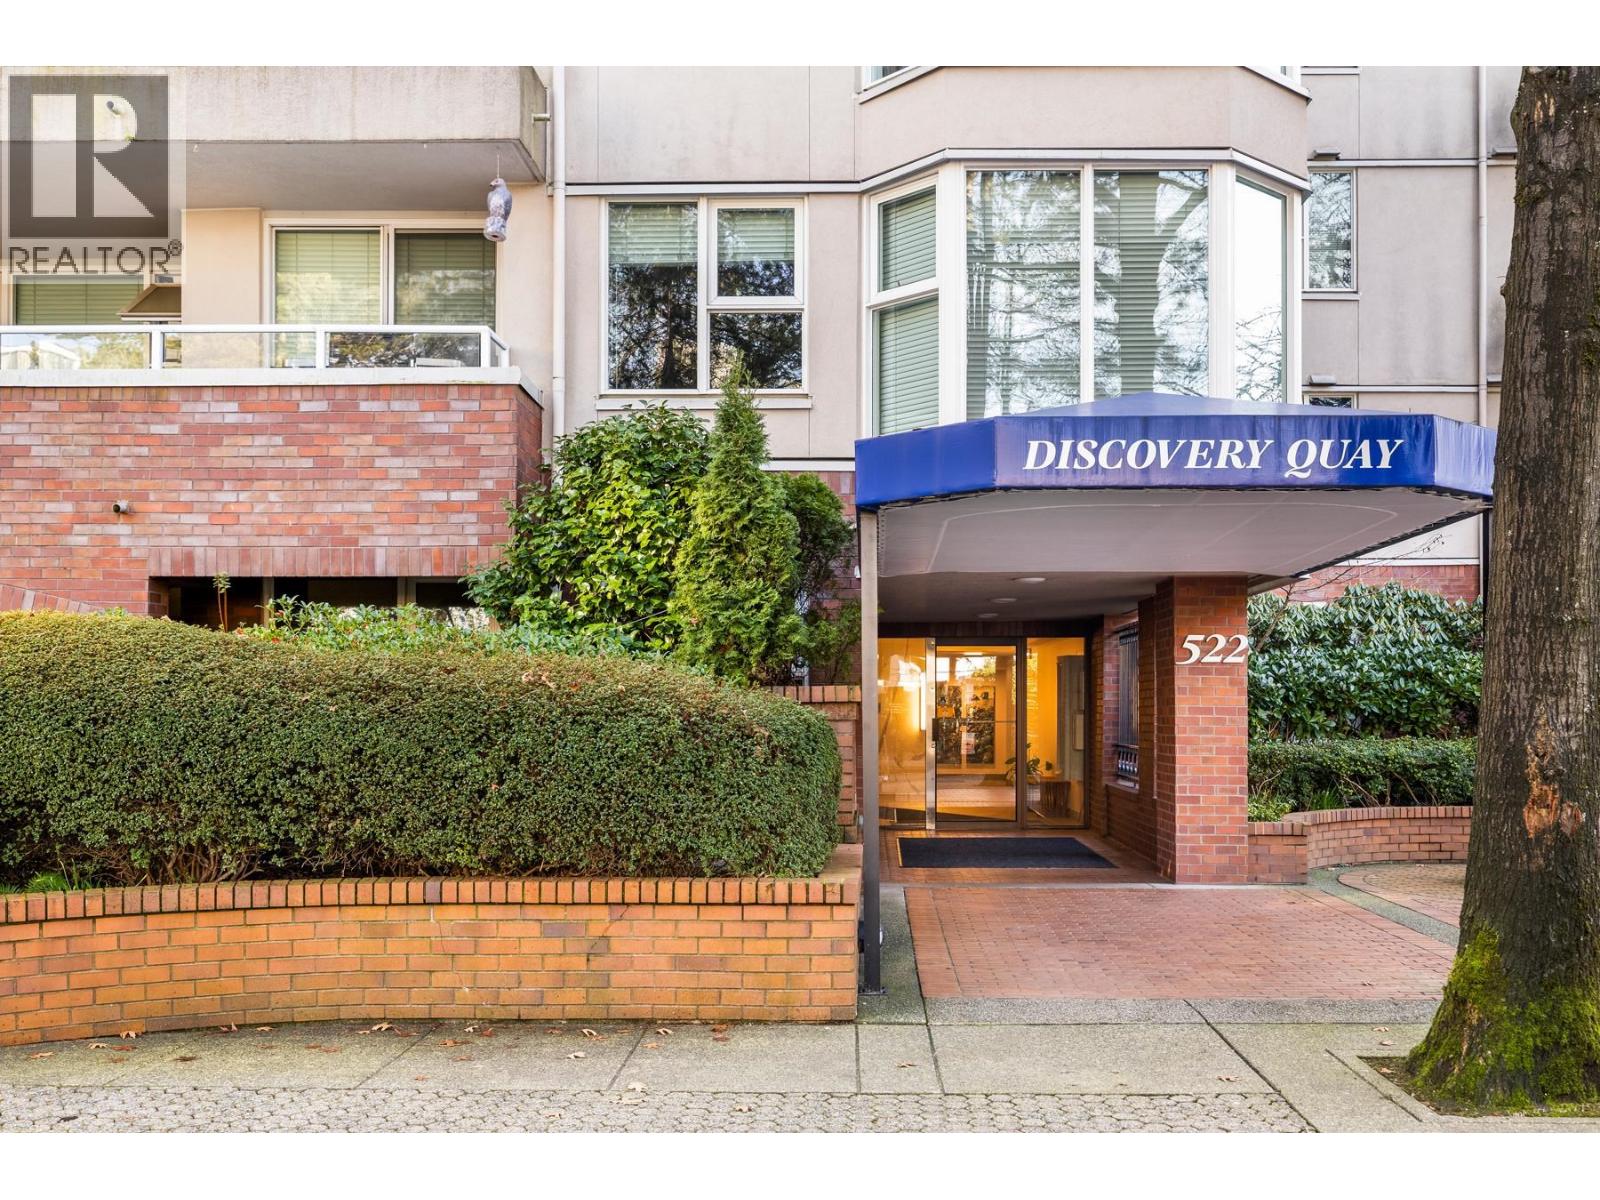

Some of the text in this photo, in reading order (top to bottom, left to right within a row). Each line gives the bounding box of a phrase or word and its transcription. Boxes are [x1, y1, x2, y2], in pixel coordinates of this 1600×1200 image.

[1022, 438, 1404, 479] DISCOVERY QUAY
[1175, 633, 1249, 665] 522
